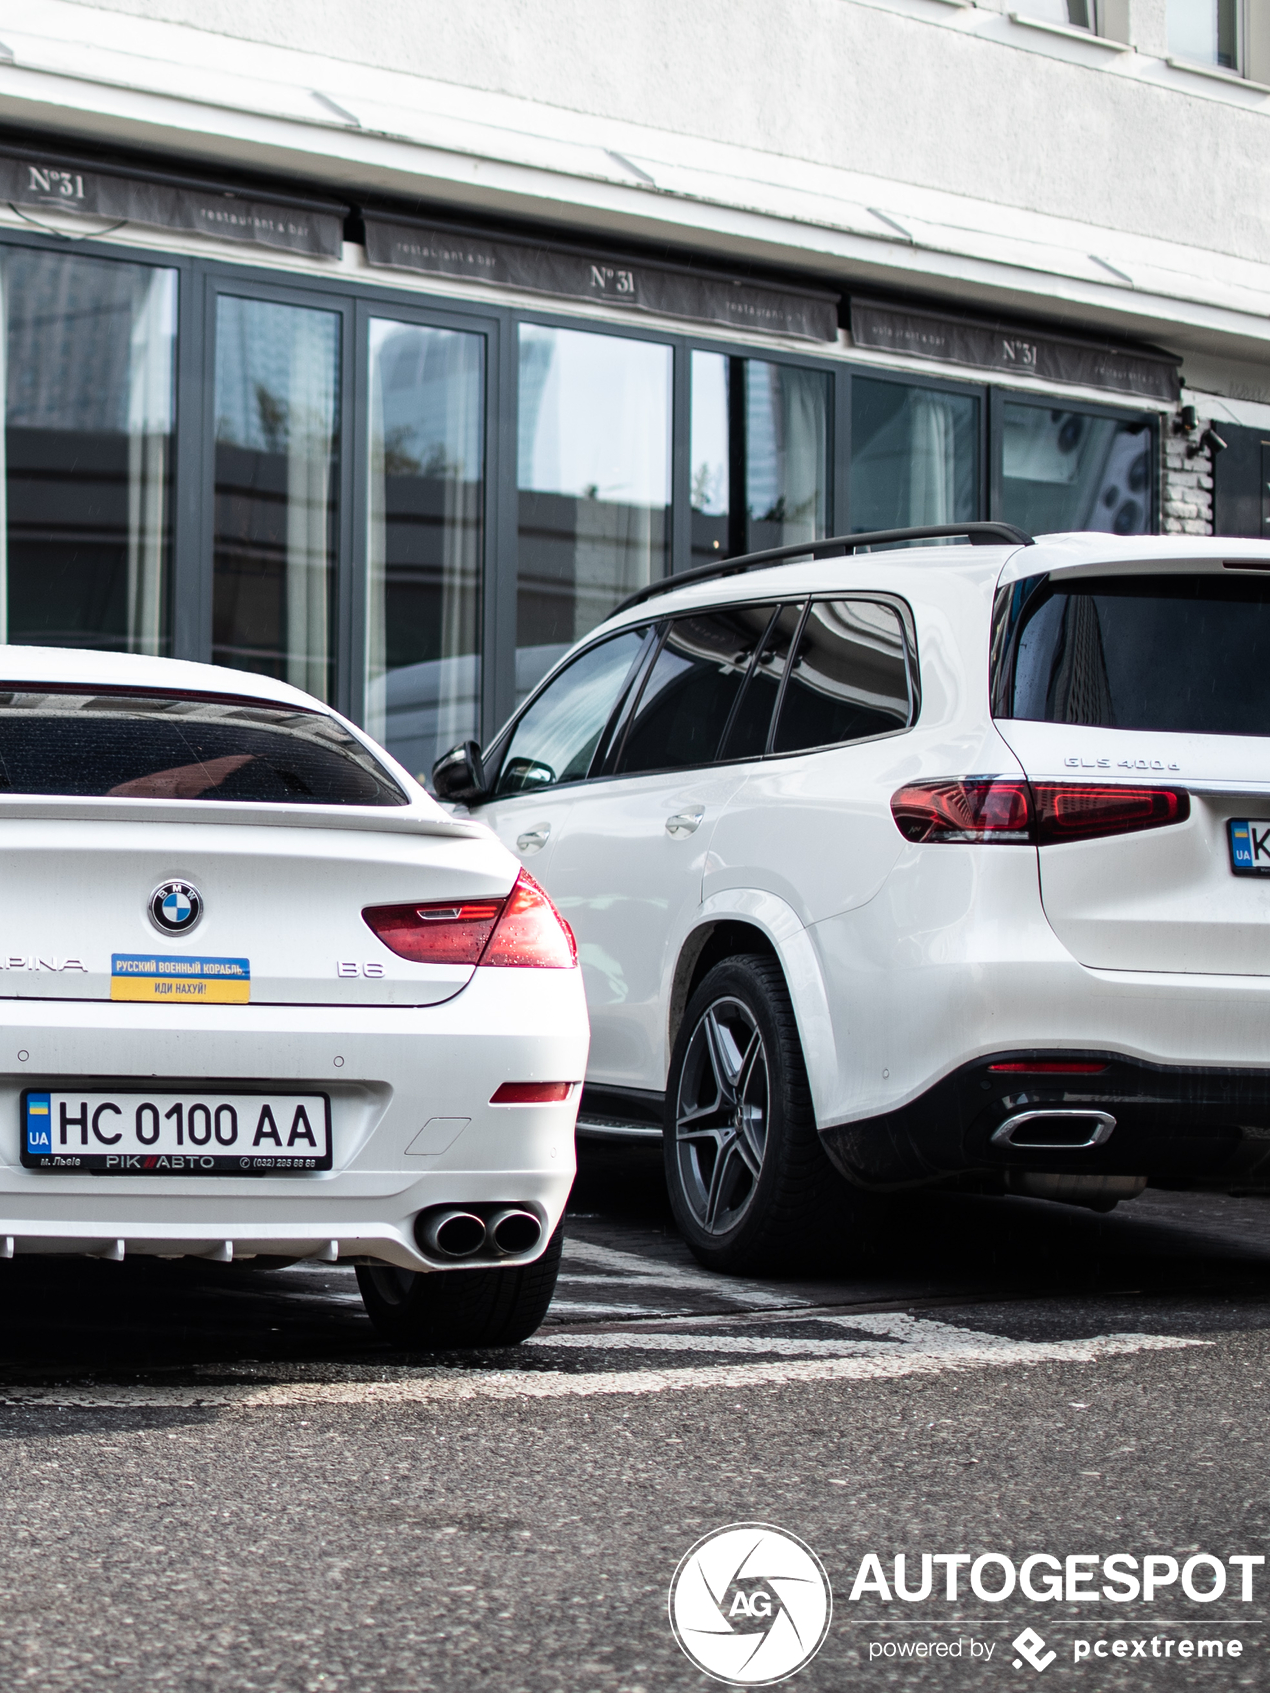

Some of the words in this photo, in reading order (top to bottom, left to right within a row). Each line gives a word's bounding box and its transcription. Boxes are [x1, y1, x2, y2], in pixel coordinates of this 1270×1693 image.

[200, 208, 274, 231] restaurant
[288, 223, 309, 237] bar
[1064, 757, 1111, 769] GLS
[1116, 758, 1166, 771] 400
[1236, 850, 1251, 860] UA
[157, 884, 197, 901] BMW
[116, 960, 157, 973] РУССКИЙ
[158, 962, 201, 975] ВОЕННЫЙ
[336, 961, 387, 979] B6
[154, 982, 173, 995] ИДИ
[175, 982, 207, 995] НАХУЙ!
[60, 1101, 123, 1146] HC
[135, 1102, 239, 1147] 0100
[252, 1104, 318, 1148] AA
[29, 1131, 49, 1145] UA
[253, 1157, 275, 1168] (032)
